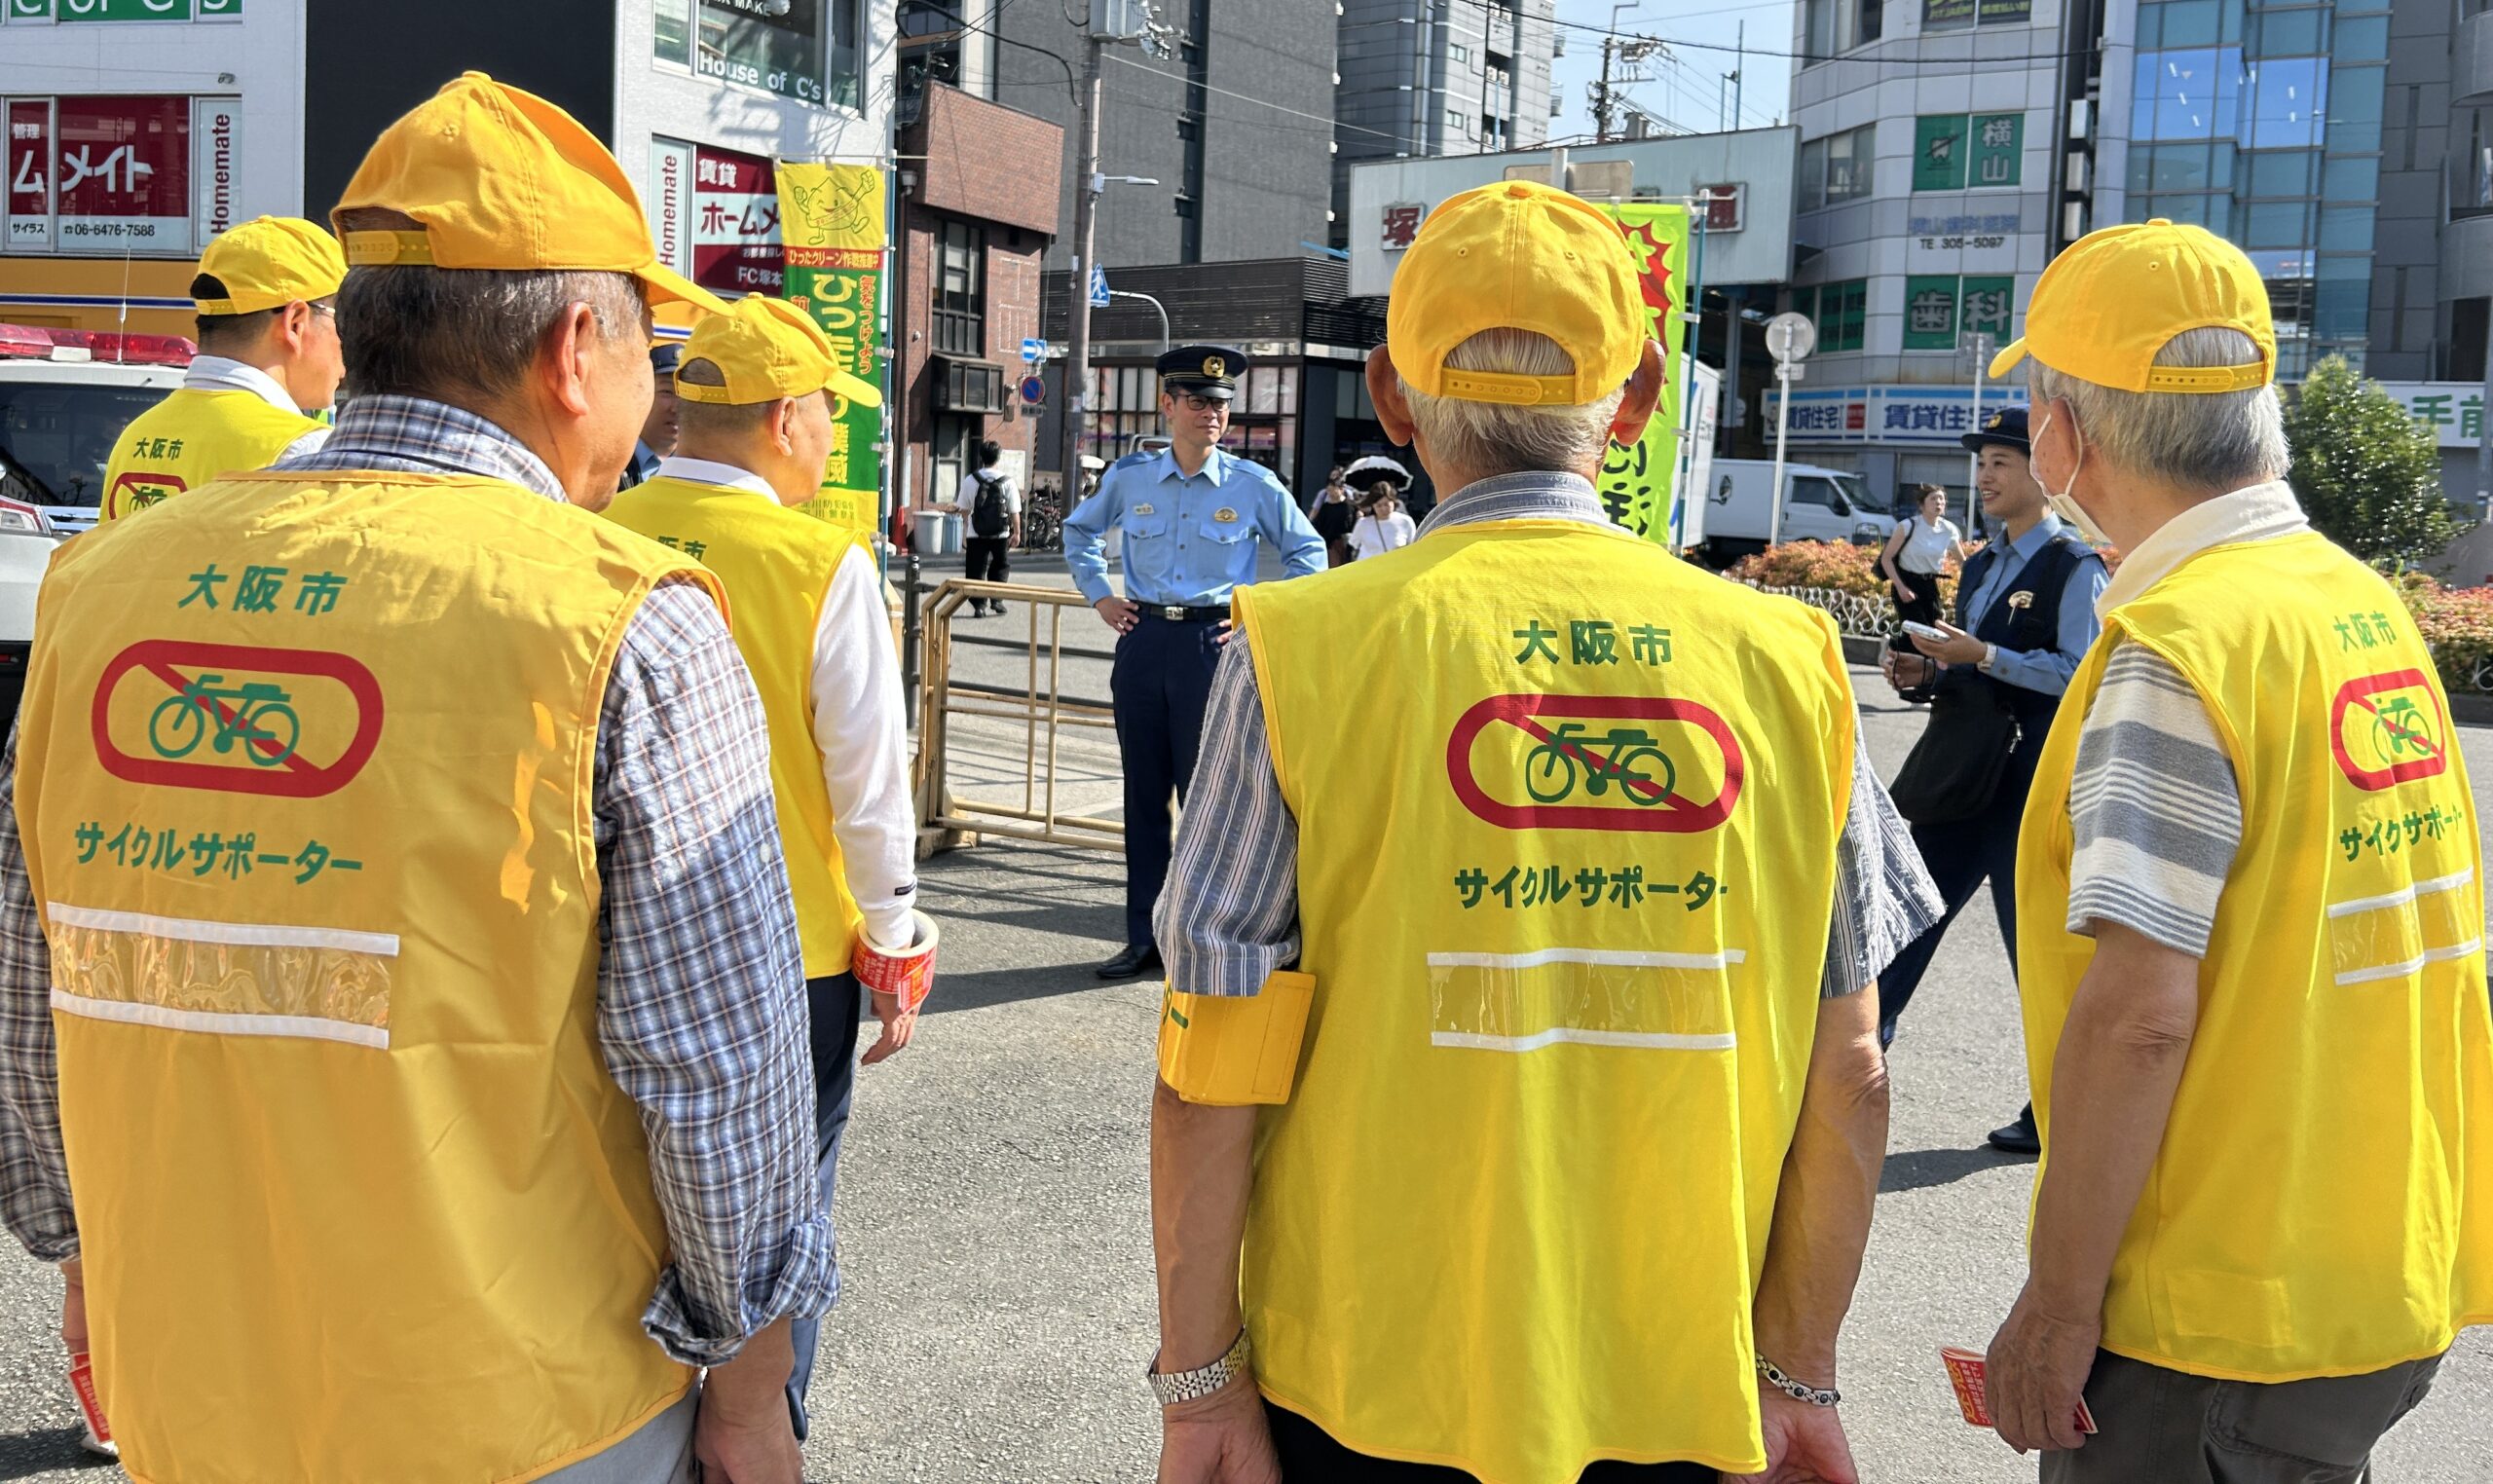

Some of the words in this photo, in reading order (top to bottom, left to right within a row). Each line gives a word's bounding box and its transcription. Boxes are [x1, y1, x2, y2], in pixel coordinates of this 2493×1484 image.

[699, 50, 759, 85] House
[767, 71, 787, 92] of
[796, 77, 822, 100] C's
[210, 113, 231, 235] Homemate
[698, 158, 737, 189] 賃貸
[1982, 118, 2013, 182] 横山
[13, 223, 45, 235] サイラス
[659, 155, 677, 266] Homemate
[859, 275, 876, 375] 気をつけよう
[1911, 290, 2009, 333] 歯科
[133, 437, 185, 461] 大阪市
[178, 563, 349, 616] 大阪市
[1512, 619, 1673, 666] 大阪市
[2332, 610, 2397, 653] 大阪市
[75, 821, 363, 885] サイクルサポーター
[1454, 864, 1728, 912] サイクルサポータ
